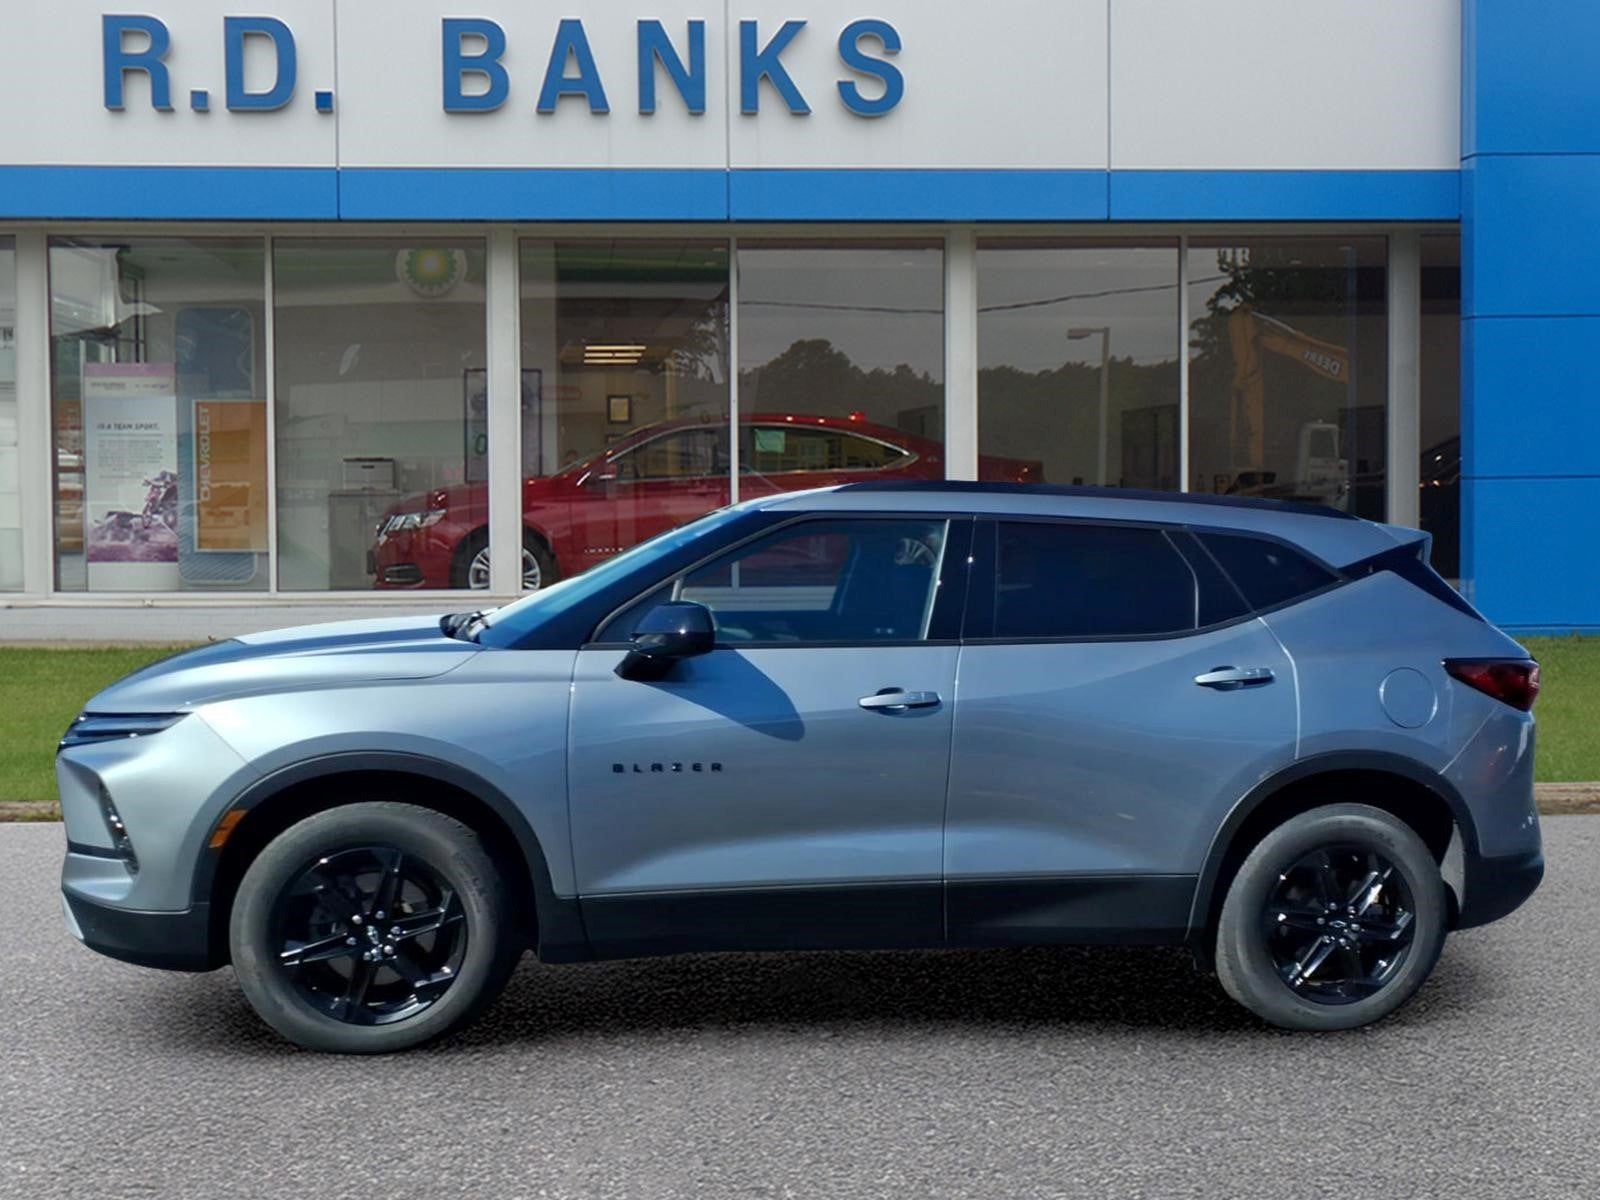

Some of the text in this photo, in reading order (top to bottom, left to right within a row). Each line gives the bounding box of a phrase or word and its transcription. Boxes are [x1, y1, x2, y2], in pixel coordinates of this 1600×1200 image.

[102, 14, 905, 117] R.D. BANKS
[200, 406, 210, 501] CHEVROLET
[612, 762, 723, 774] BLAZER
